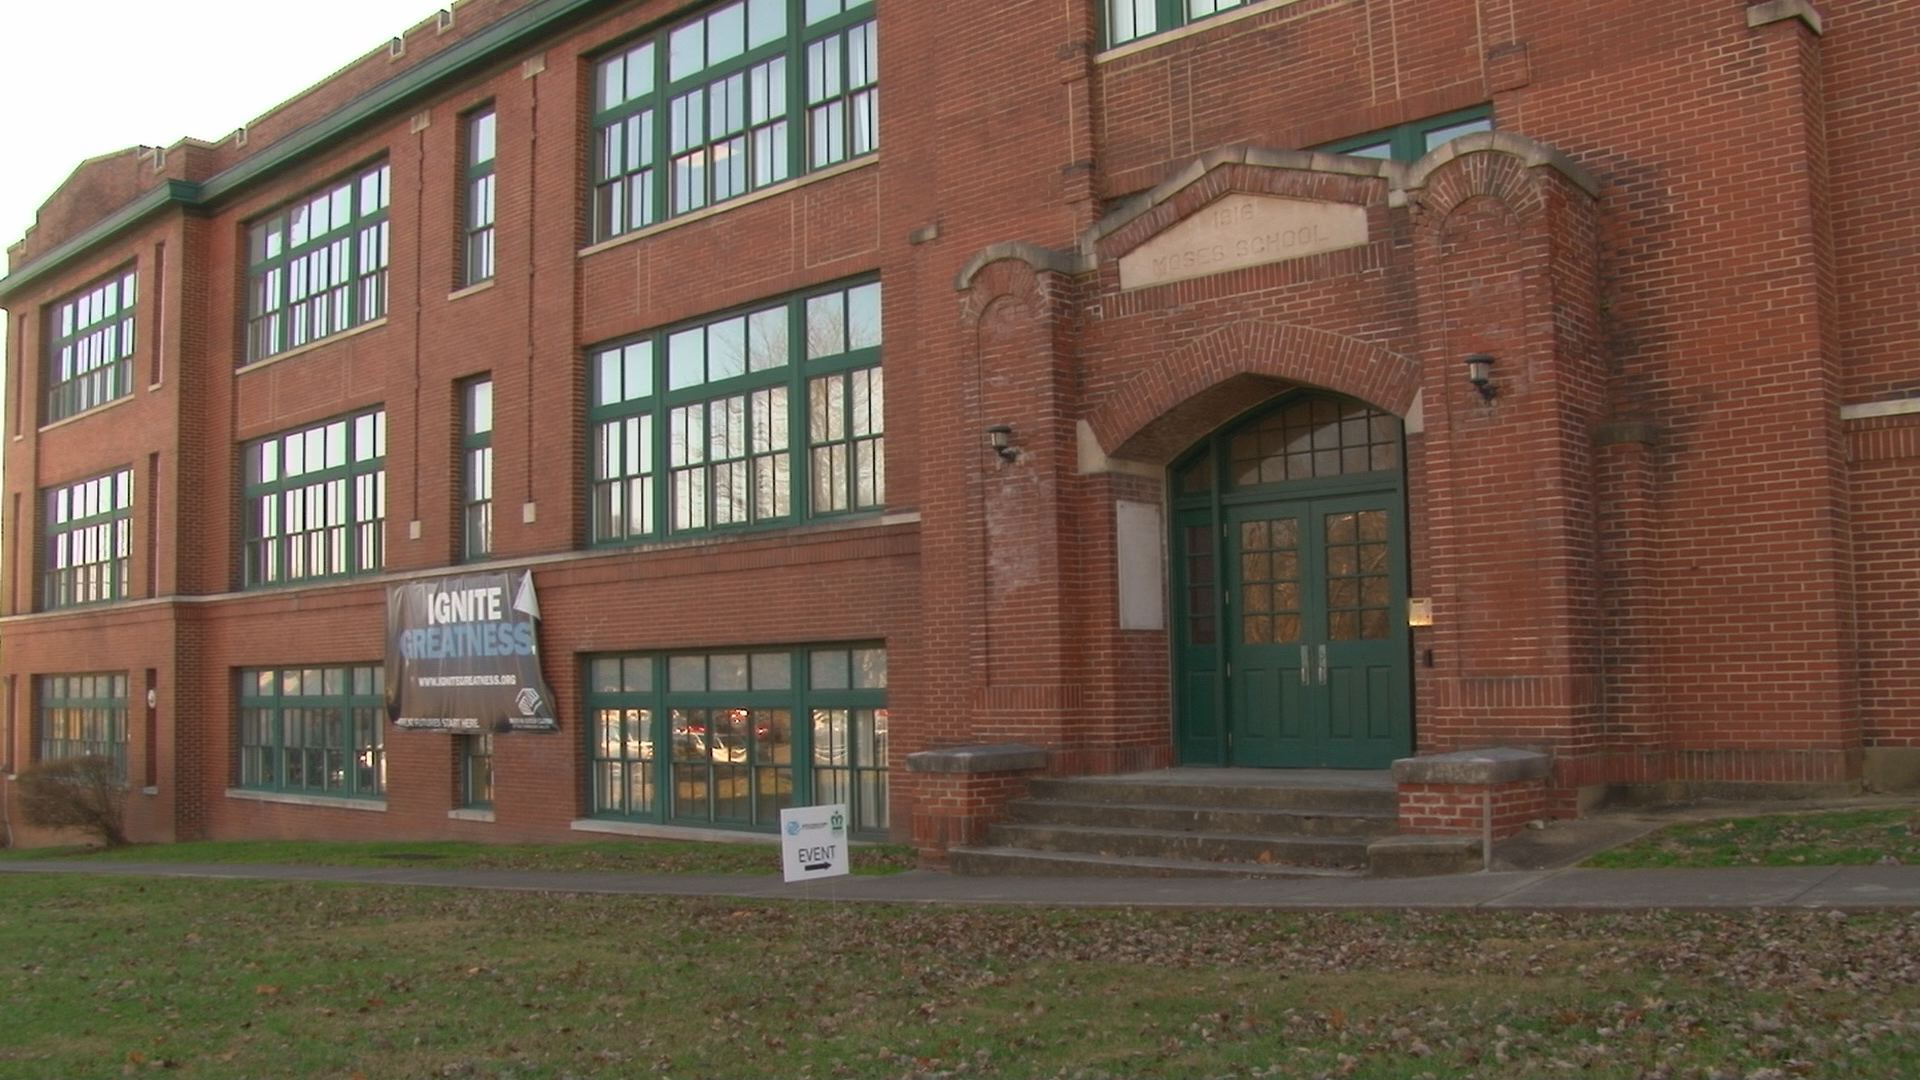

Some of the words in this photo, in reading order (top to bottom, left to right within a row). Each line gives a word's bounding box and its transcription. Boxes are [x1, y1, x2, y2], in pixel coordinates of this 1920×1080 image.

[1152, 244, 1225, 275] MOSES
[1235, 224, 1329, 257] SCHOOL
[427, 586, 502, 625] IGNITE
[798, 845, 836, 863] EVENT
